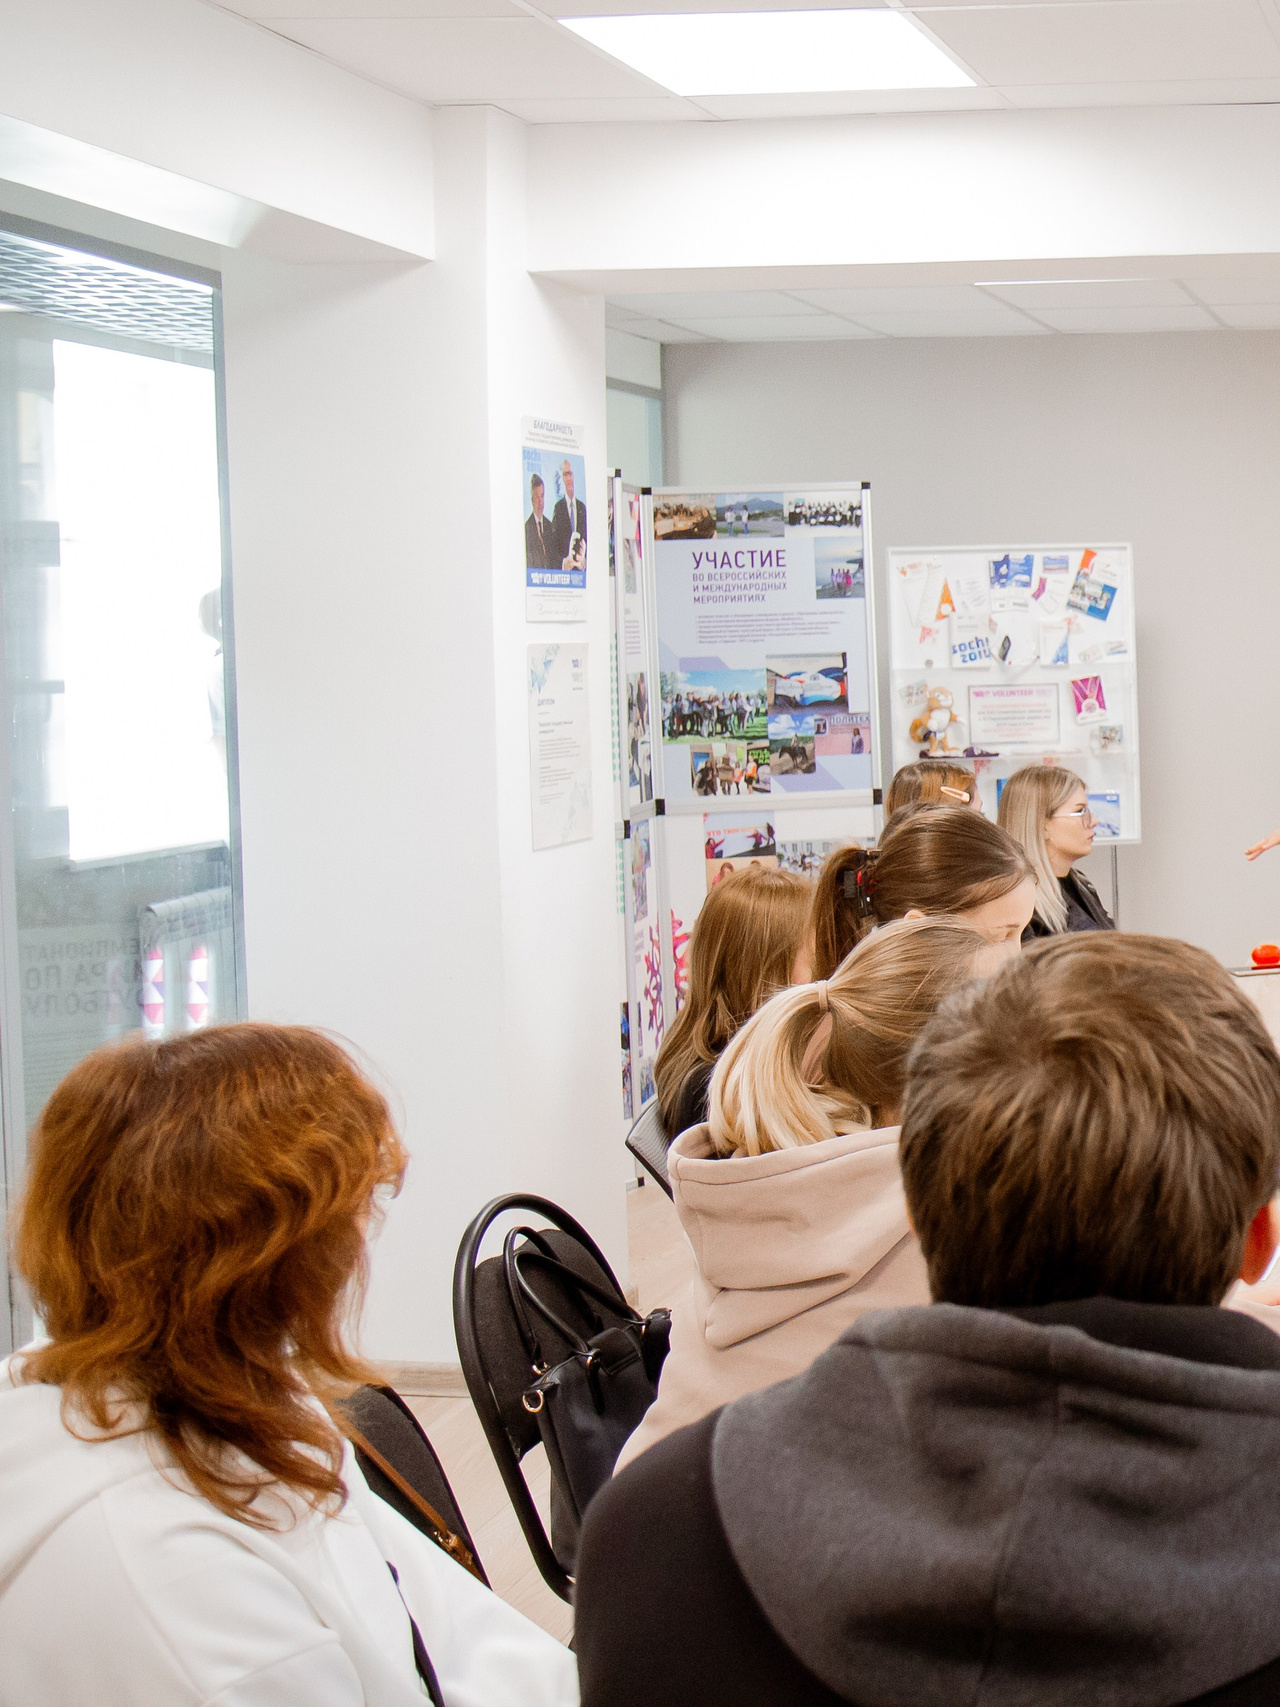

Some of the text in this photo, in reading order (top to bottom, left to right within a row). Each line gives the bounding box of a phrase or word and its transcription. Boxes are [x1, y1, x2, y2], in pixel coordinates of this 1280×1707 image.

[692, 549, 787, 570] УЧАСТИЕ
[692, 569, 787, 582] ВО ВСЕРОССИЙСКИХ
[693, 582, 787, 593] И МЕЖДУНАРОДНЫХ
[693, 594, 766, 604] МЕРОПРИЯТИЯХ
